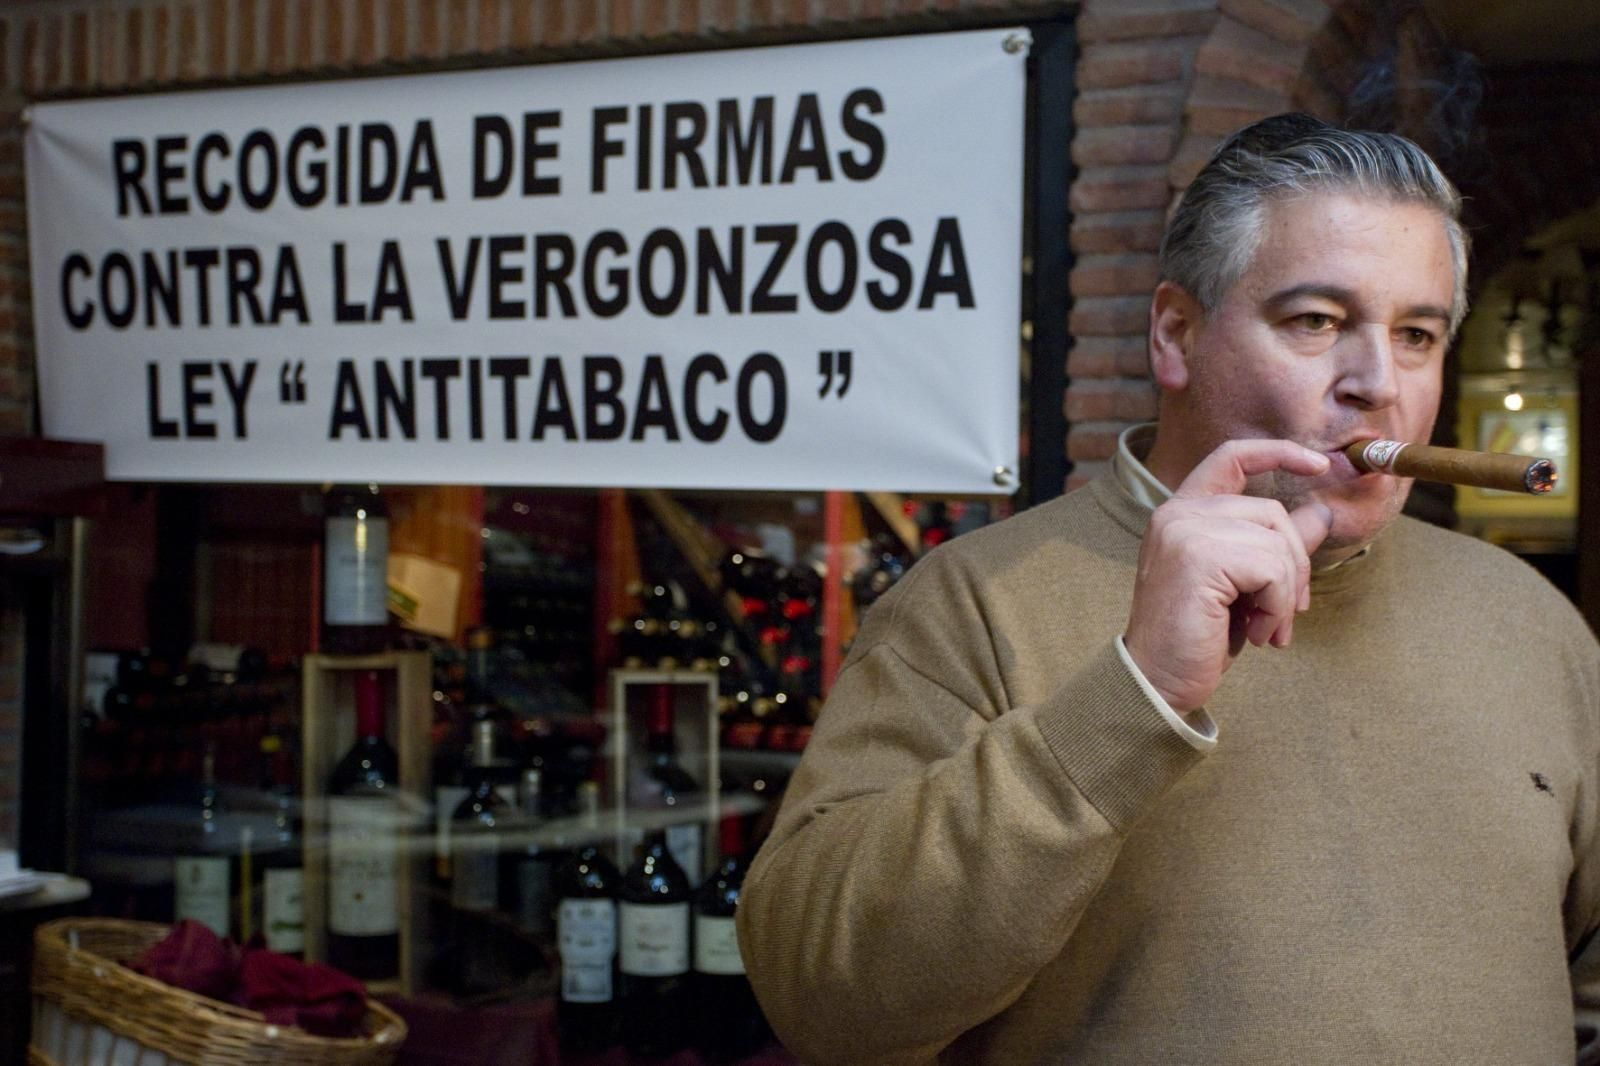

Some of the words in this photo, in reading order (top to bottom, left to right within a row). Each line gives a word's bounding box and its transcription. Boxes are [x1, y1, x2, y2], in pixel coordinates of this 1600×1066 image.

[114, 119, 446, 218] RECOGIDA
[471, 110, 562, 200] DE
[591, 88, 886, 194] FIRMAS
[60, 243, 311, 334] CONTRA
[332, 239, 415, 325] LA
[435, 217, 976, 321] VERGONZOSA
[146, 360, 259, 441] LEY
